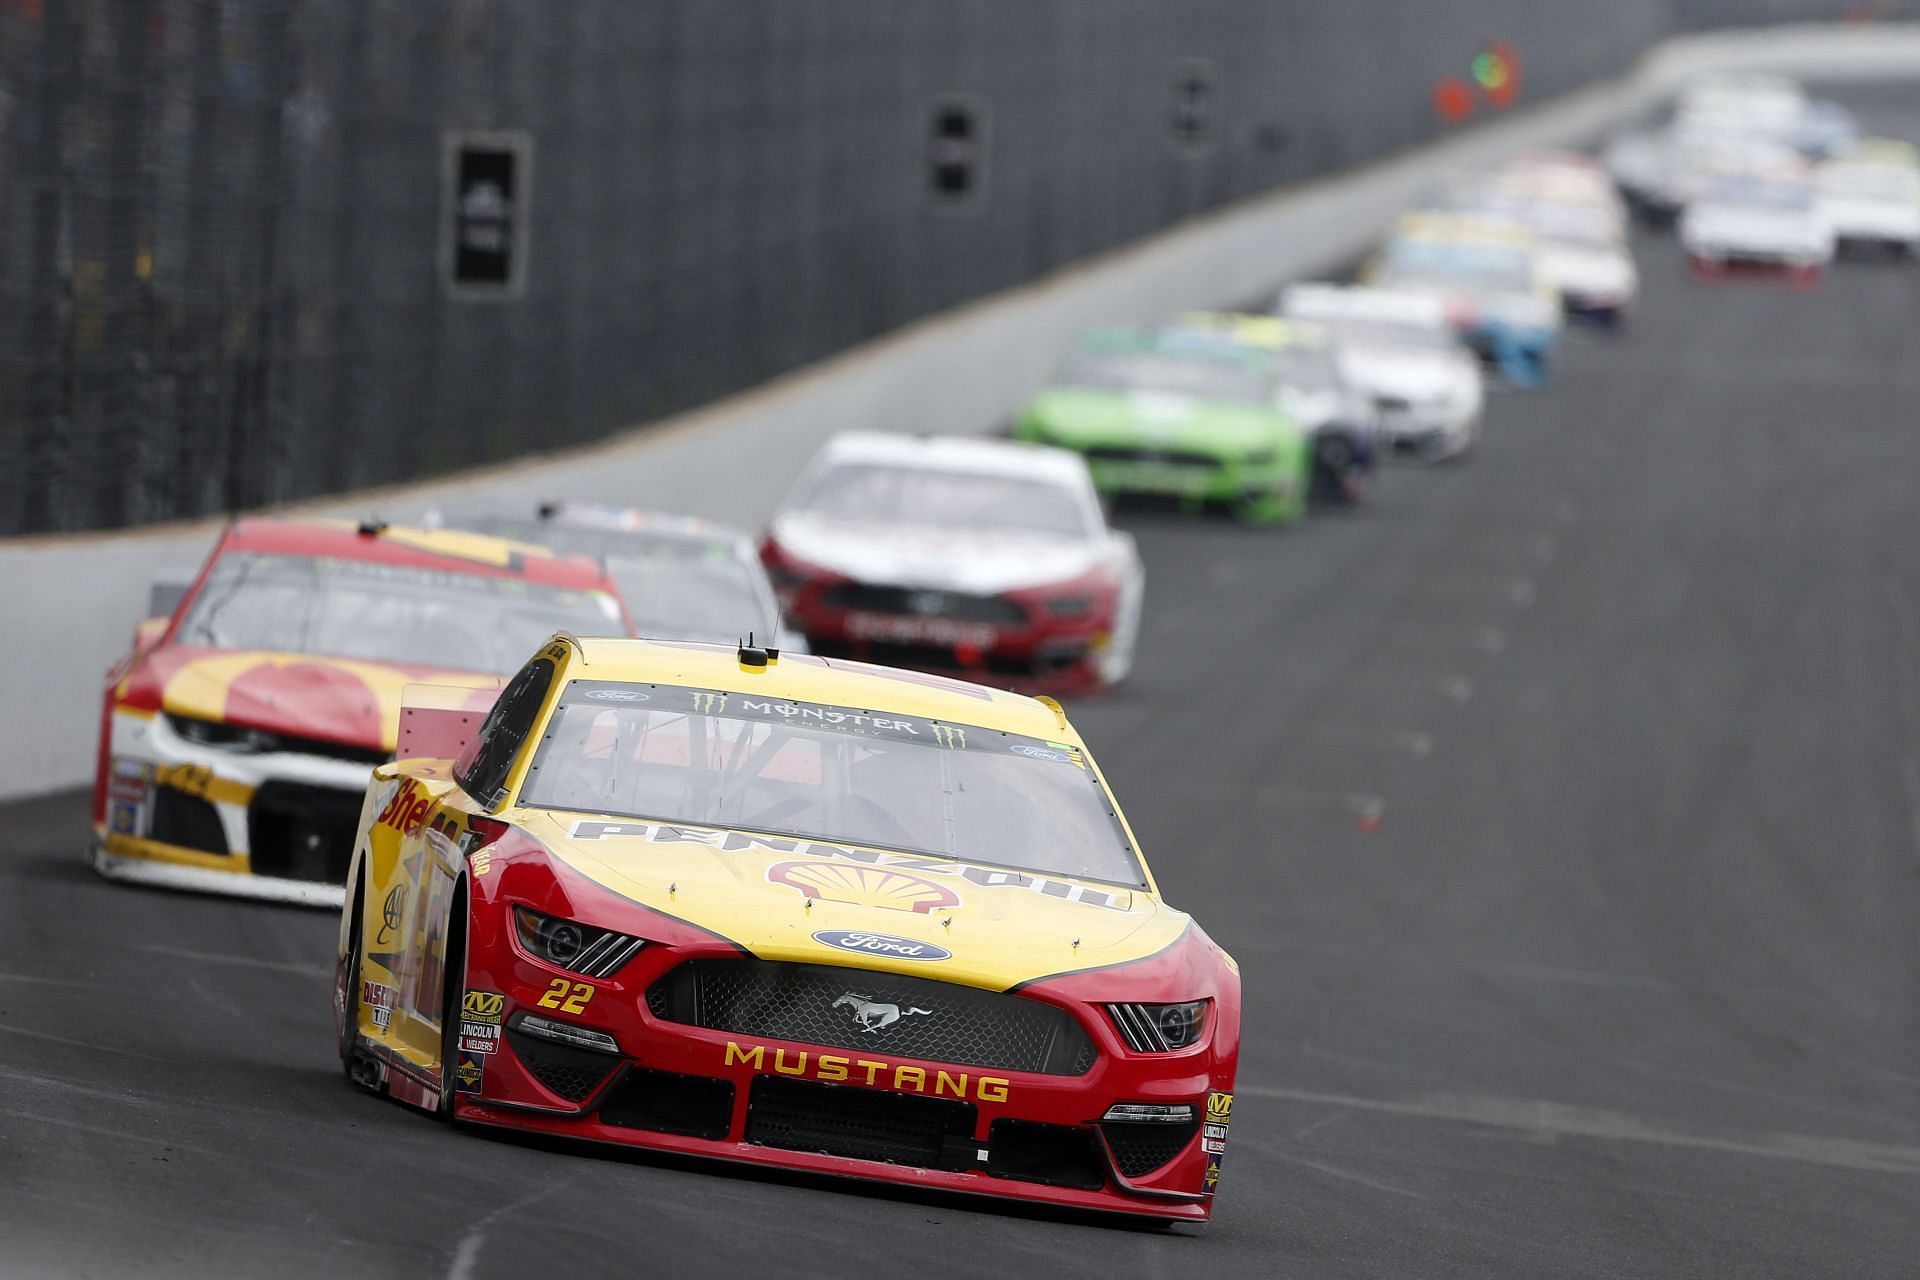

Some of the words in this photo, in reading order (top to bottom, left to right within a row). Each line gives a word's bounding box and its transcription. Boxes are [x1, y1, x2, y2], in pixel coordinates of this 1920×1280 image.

[742, 700, 920, 735] MONSTER
[785, 718, 881, 736] ENERGY
[567, 819, 1130, 913] PENNZOIL
[840, 931, 922, 957] Ford
[536, 978, 595, 1015] 22
[466, 1038, 494, 1052] WELDERS
[724, 1041, 1010, 1103] MUSTANG
